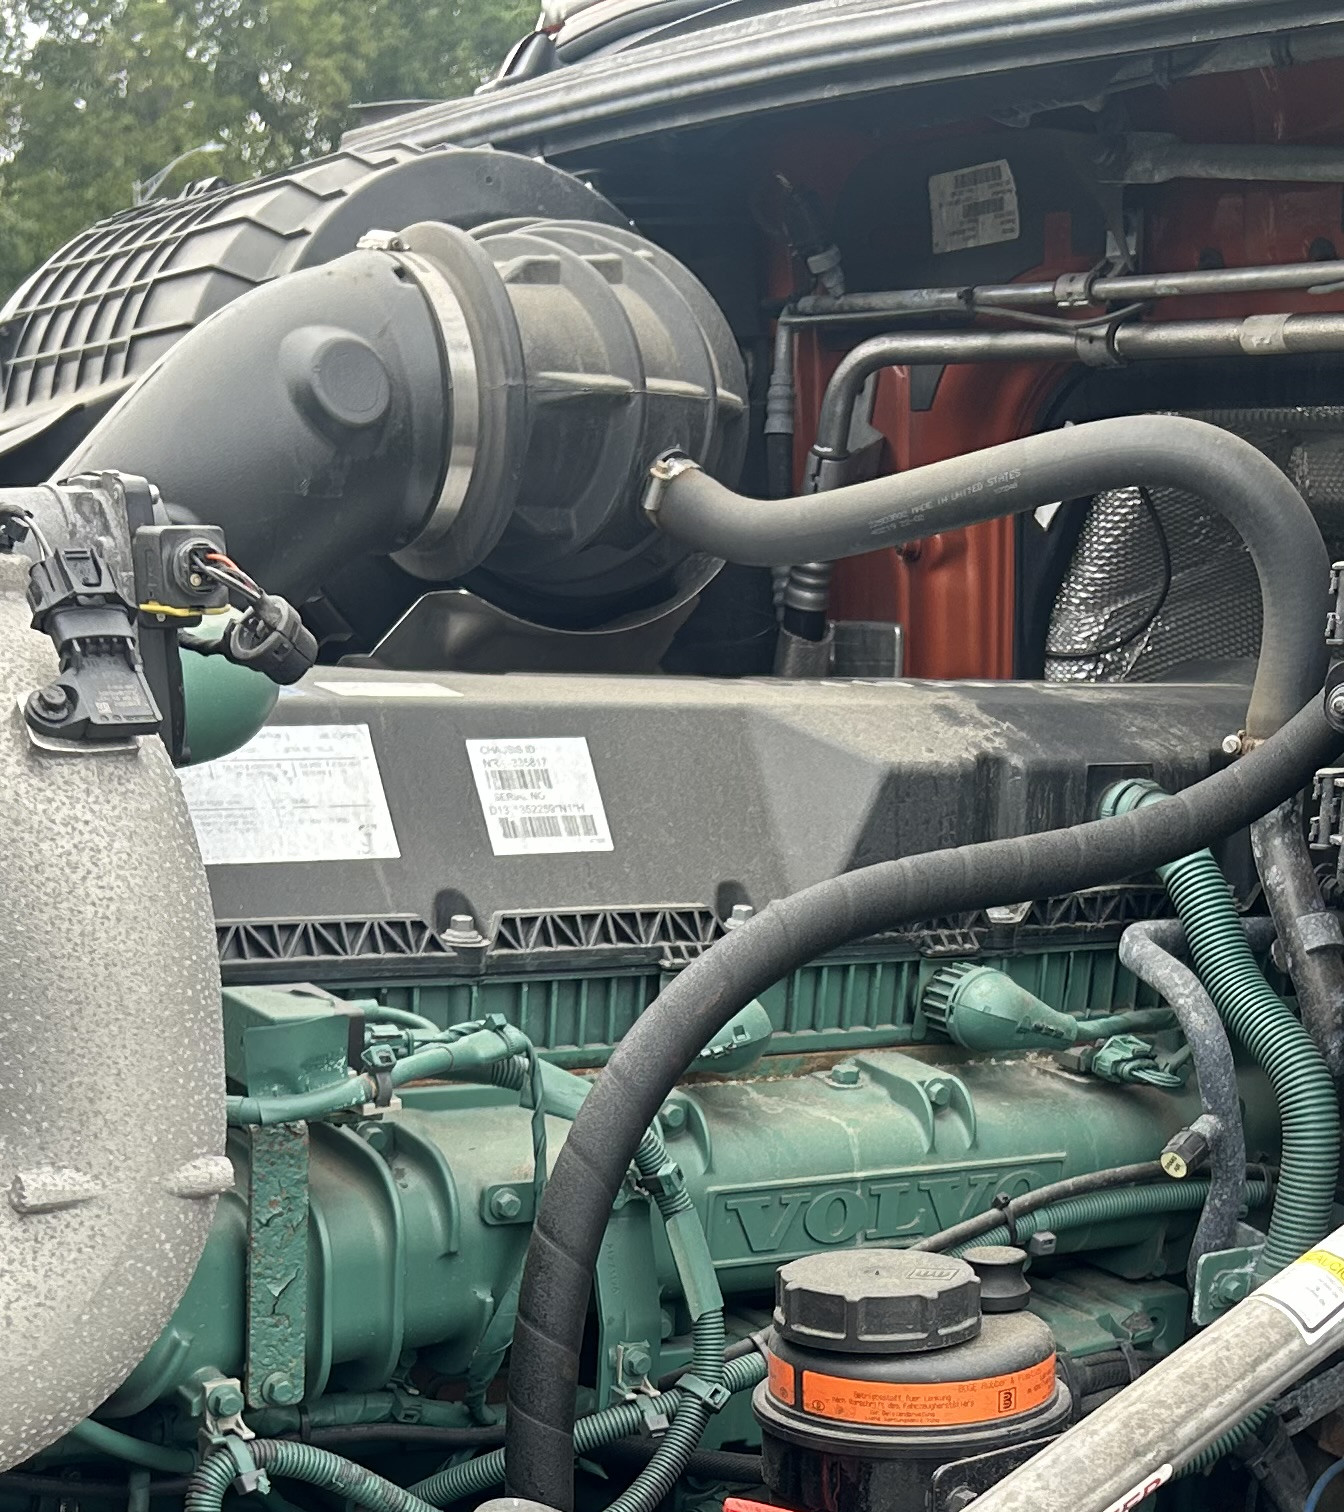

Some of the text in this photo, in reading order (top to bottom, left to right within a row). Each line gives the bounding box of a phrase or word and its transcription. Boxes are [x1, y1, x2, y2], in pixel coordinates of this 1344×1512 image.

[951, 482, 983, 500] UNITED
[987, 468, 1021, 487] STATES
[525, 745, 535, 754] ID
[726, 1169, 1048, 1252] VOLVO
